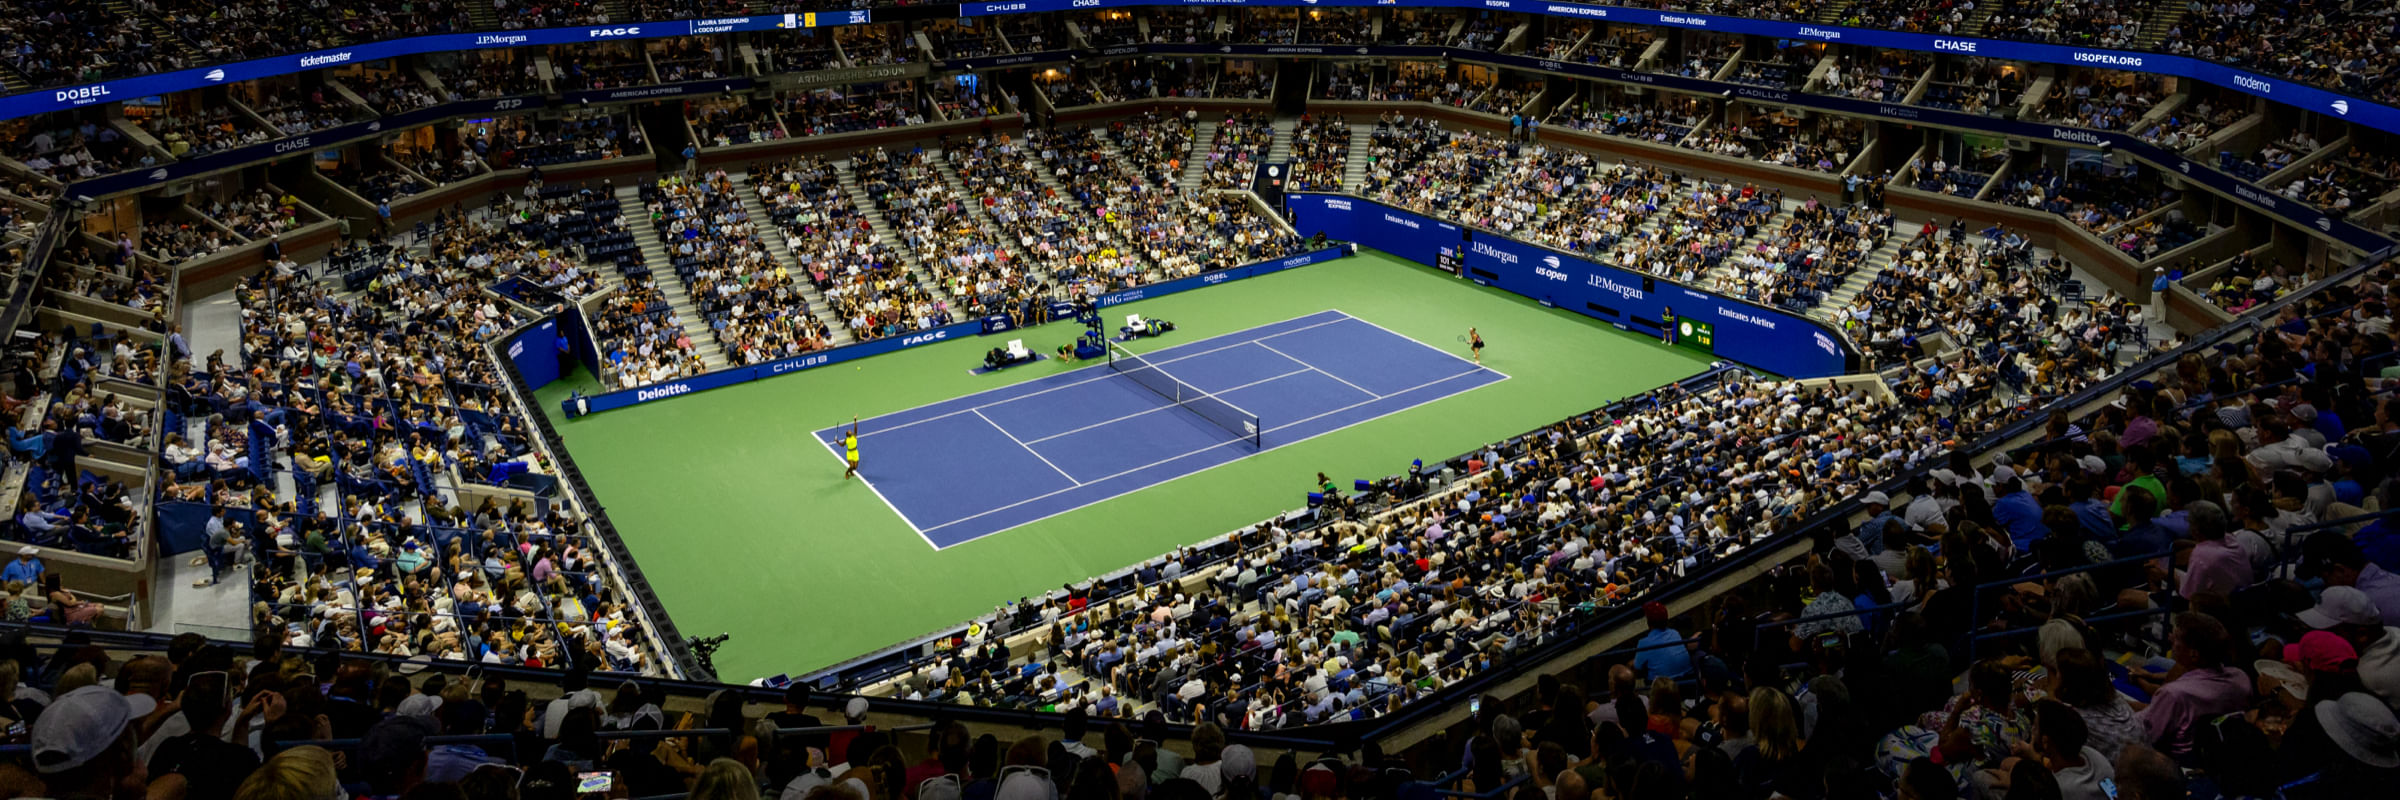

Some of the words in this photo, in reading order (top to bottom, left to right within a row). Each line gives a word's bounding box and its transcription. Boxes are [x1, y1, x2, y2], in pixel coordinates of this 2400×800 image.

[986, 2, 1026, 12] CHUBB
[1547, 5, 1578, 14] AMERICAN
[1579, 8, 1606, 17] EXPRESS
[849, 15, 866, 23] IBM
[1660, 14, 1685, 24] Emirates
[1686, 17, 1706, 26] Airline
[1934, 40, 1977, 52] CHASE
[301, 52, 351, 67] ticketmaster
[1539, 60, 1561, 70] DOBEL
[2074, 52, 2142, 67] USOPEN.ORG
[866, 66, 905, 78] STADIUM
[1621, 73, 1652, 83] CHUBB
[2234, 73, 2270, 94] moderna
[56, 85, 110, 102] DOBEL
[610, 89, 649, 98] AMERICAN
[650, 86, 682, 96] EXPRESS
[1738, 88, 1788, 101] CADILLAC
[2053, 129, 2100, 145] Deloitte.
[275, 137, 310, 153] CHASE
[1324, 198, 1351, 206] AMERICAN
[1283, 255, 1311, 267] moderna
[1204, 272, 1228, 283] DOBEL
[1104, 294, 1122, 306] IHG
[1718, 306, 1749, 323] Emirates
[1750, 314, 1775, 330] Airline
[773, 355, 827, 373] CHUBB
[638, 382, 691, 401] Deloitte.
